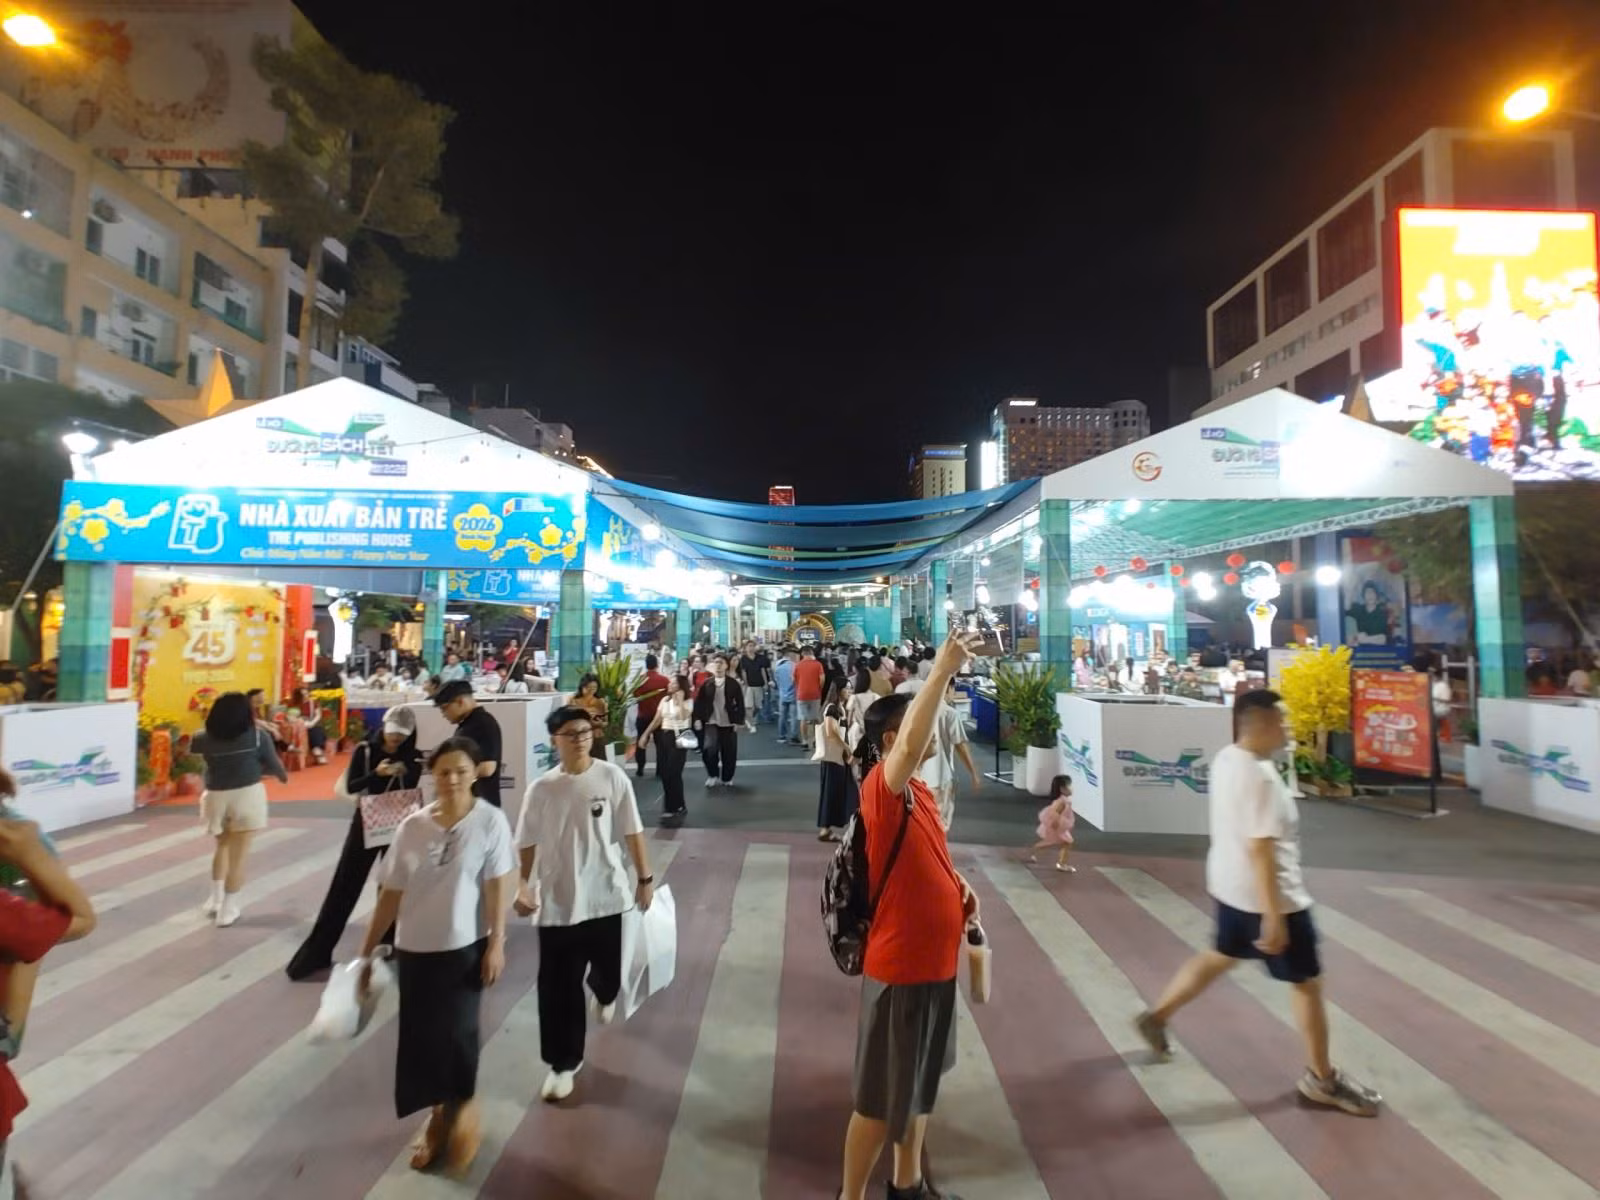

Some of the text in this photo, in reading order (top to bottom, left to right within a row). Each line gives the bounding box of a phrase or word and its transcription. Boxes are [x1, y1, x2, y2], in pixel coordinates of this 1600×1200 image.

[239, 499, 289, 527] NHÀ
[354, 500, 403, 529] BẢN
[406, 500, 449, 530] TRẺ
[460, 517, 496, 531] 2026
[268, 530, 413, 548] THE PUBLISHING HOUSE
[191, 630, 225, 658] 45
